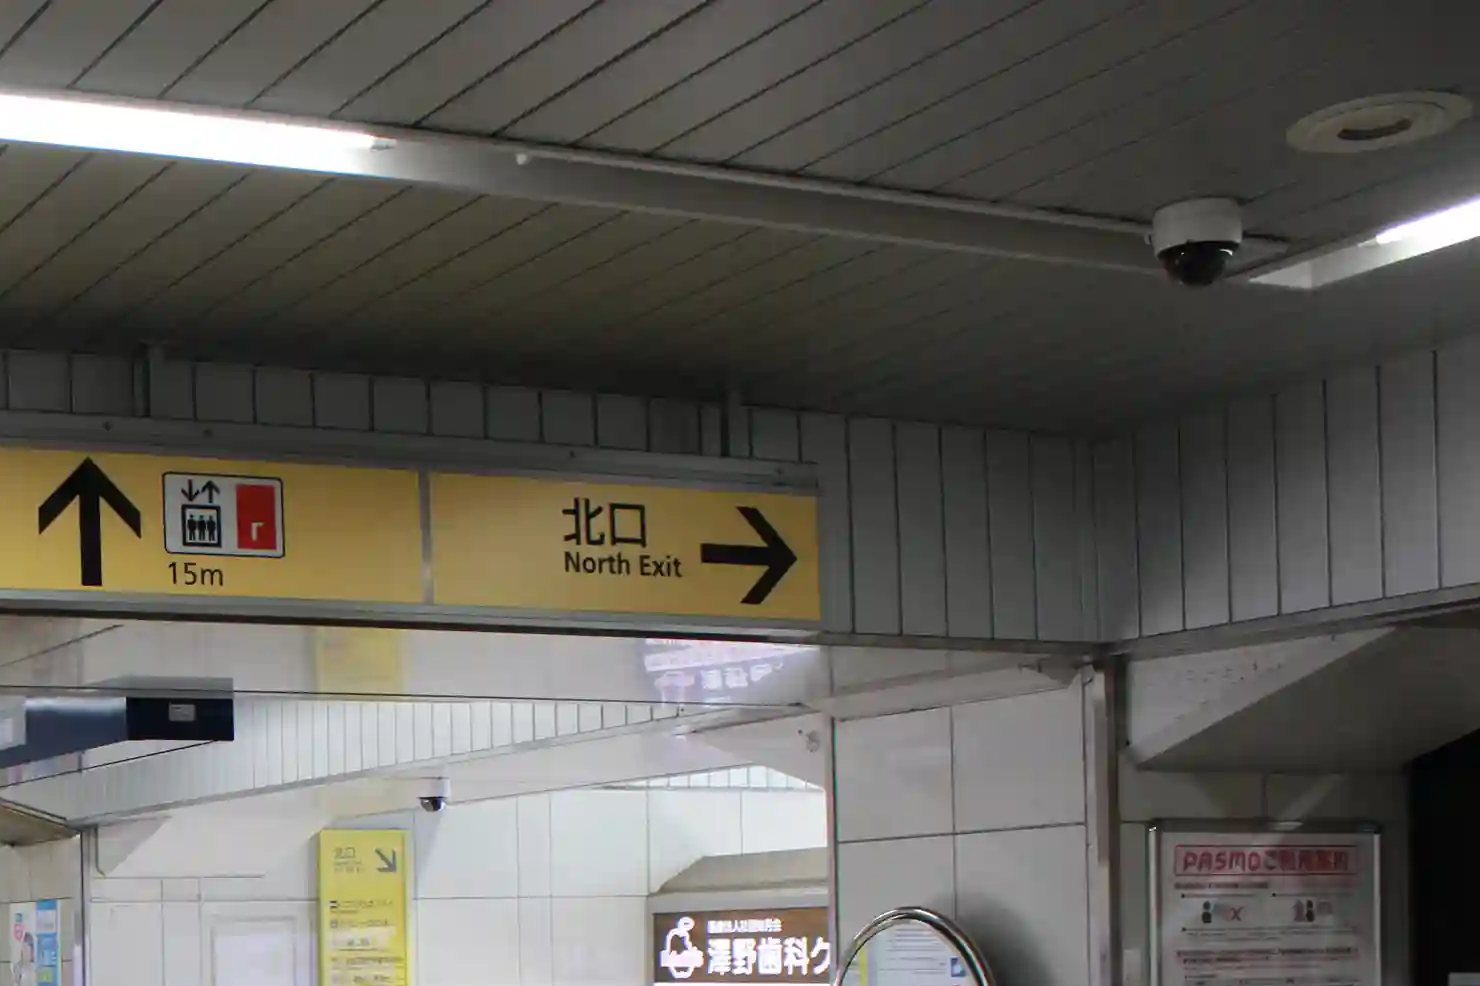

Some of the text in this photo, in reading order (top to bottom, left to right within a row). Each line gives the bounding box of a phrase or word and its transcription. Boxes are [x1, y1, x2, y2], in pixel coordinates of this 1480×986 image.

[561, 496, 647, 548] 北口
[168, 561, 224, 587] 15m
[564, 551, 683, 578] North Exit
